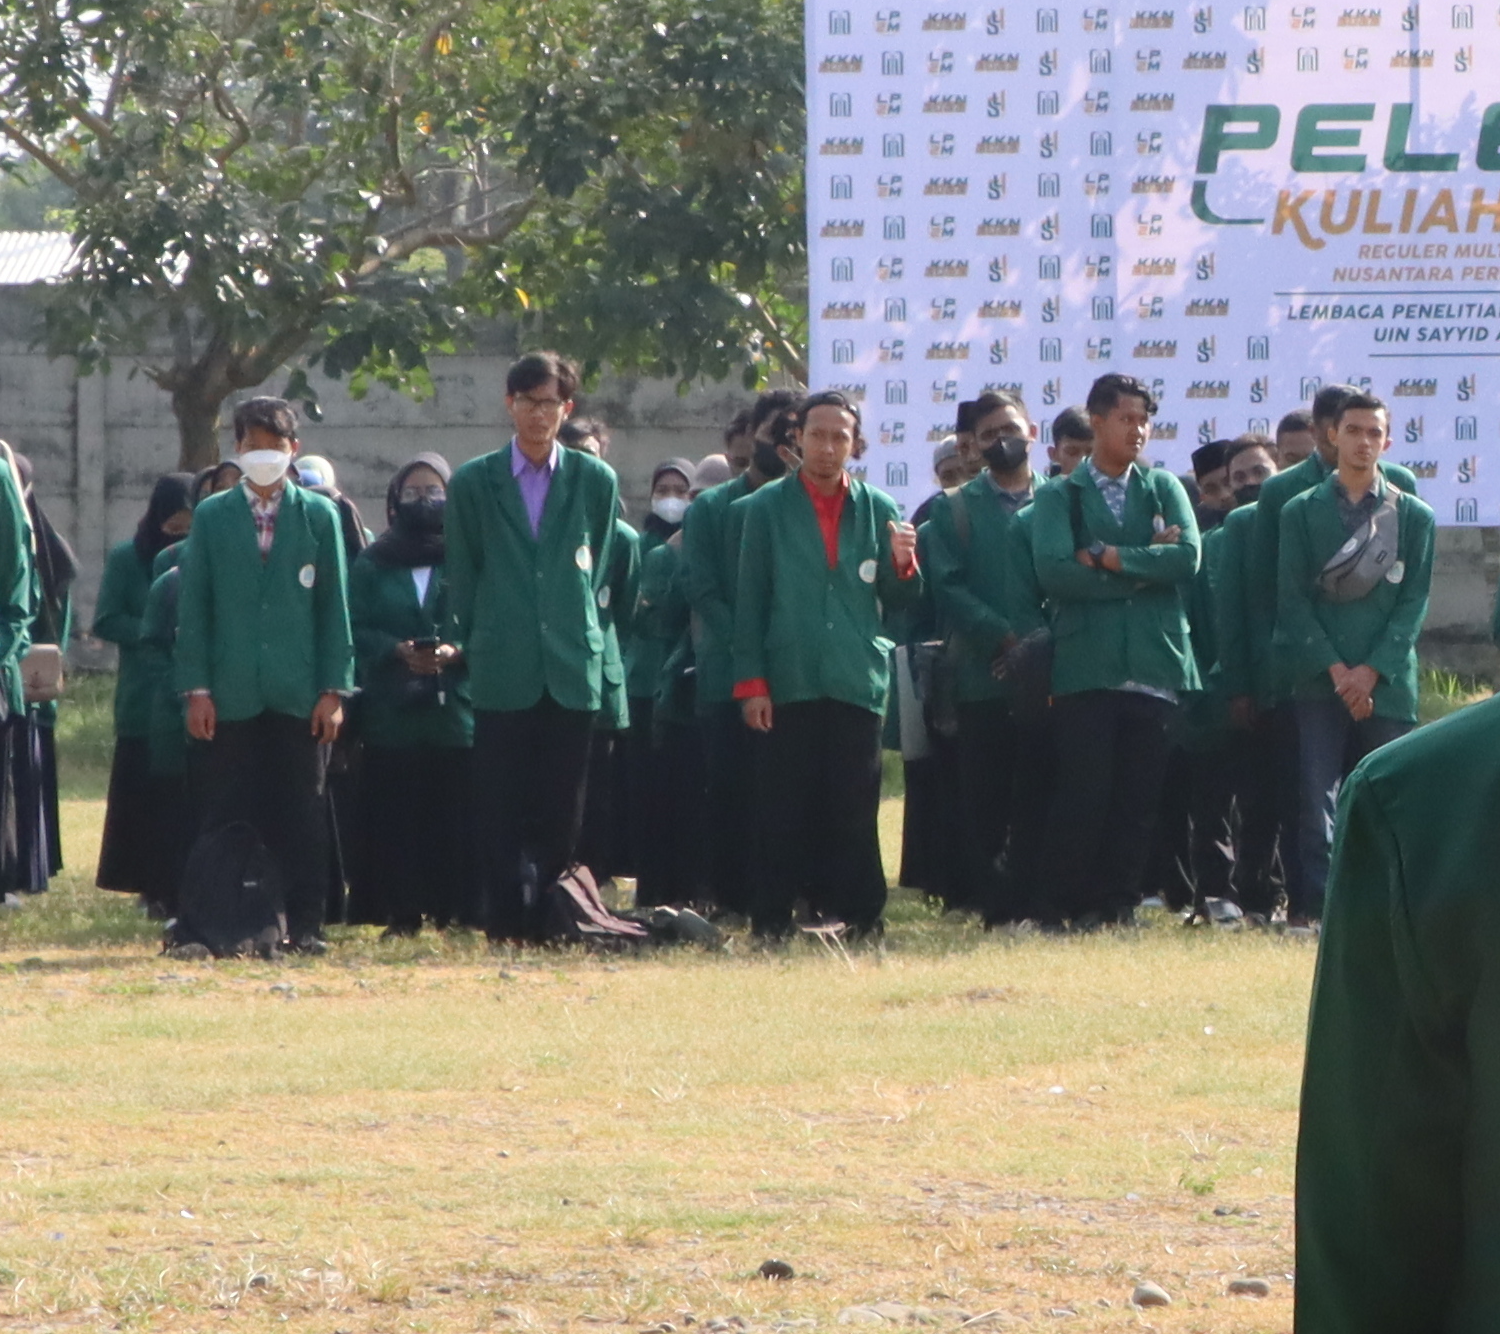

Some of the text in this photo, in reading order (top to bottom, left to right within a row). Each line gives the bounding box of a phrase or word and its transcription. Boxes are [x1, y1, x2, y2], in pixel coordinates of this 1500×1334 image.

[1358, 243, 1448, 259] REGULER
[1332, 265, 1454, 282] NUSANTARA
[1287, 304, 1384, 321] LEMBAGA
[1373, 327, 1410, 342] UIN
[1416, 326, 1489, 342] SAYYID
